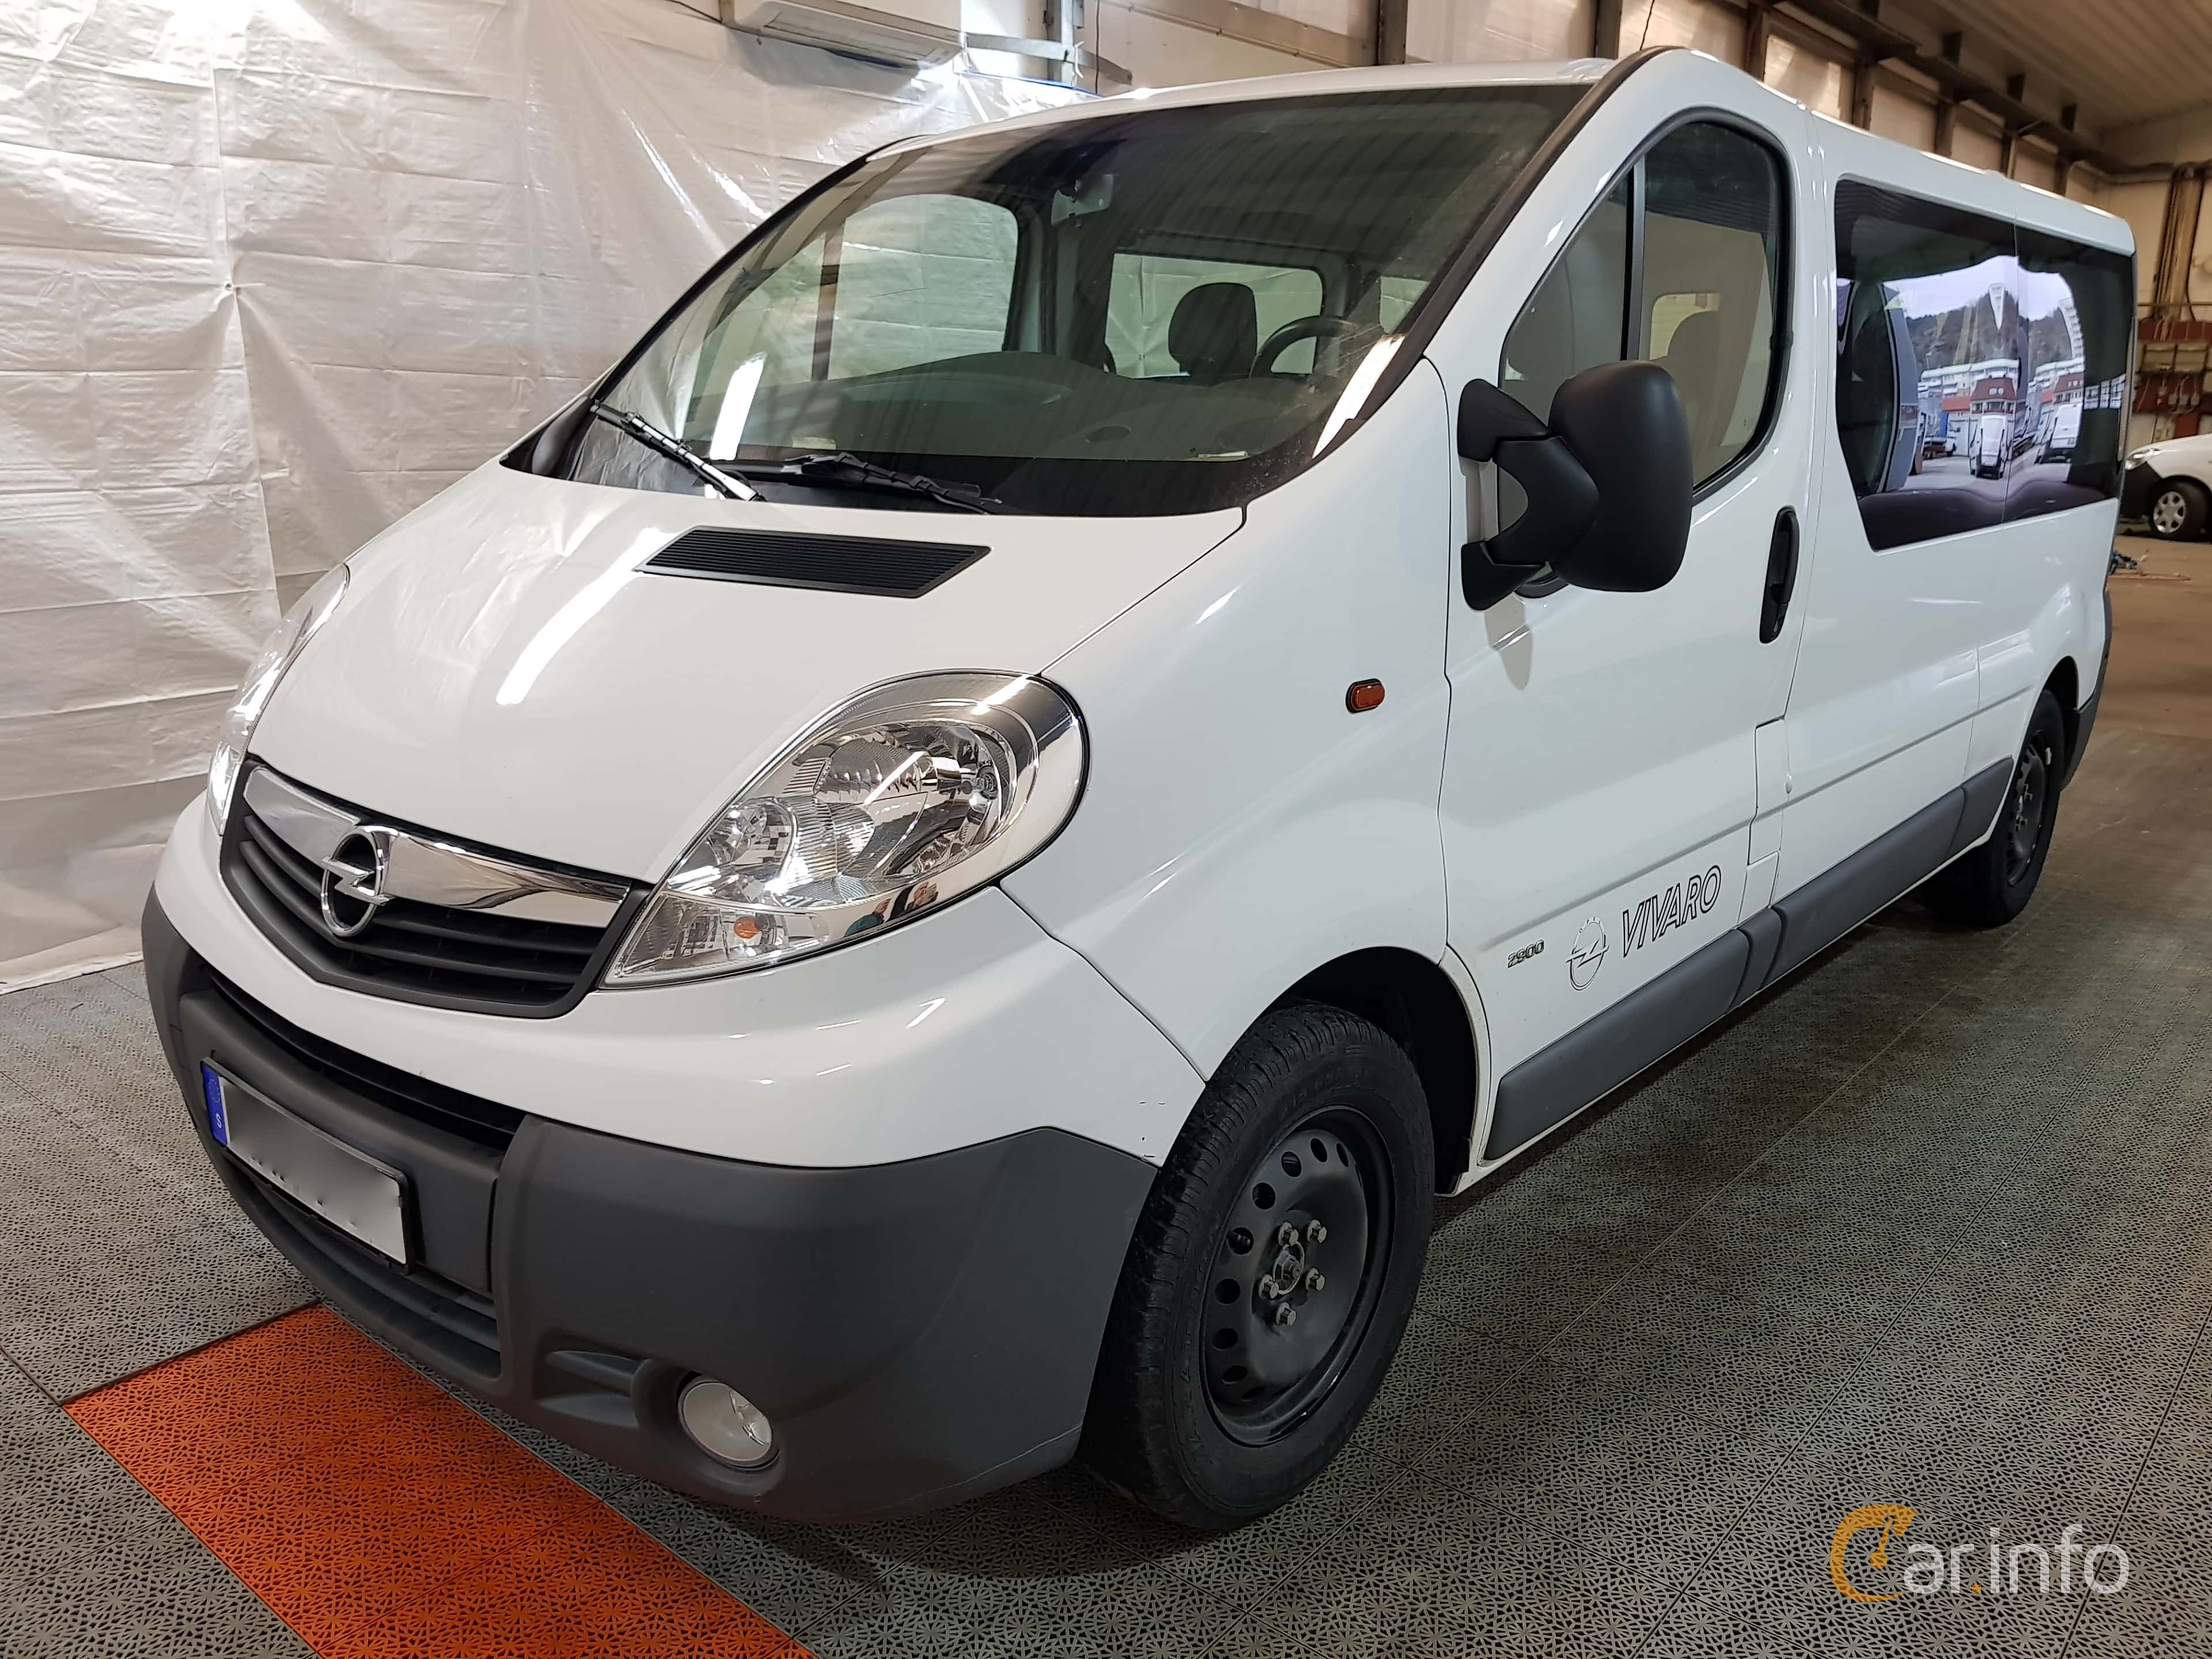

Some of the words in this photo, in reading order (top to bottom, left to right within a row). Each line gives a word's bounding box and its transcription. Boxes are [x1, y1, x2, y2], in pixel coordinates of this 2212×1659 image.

[1622, 865, 1721, 958] VIVARO
[1508, 940, 1544, 968] 2900
[215, 1113, 222, 1128] S
